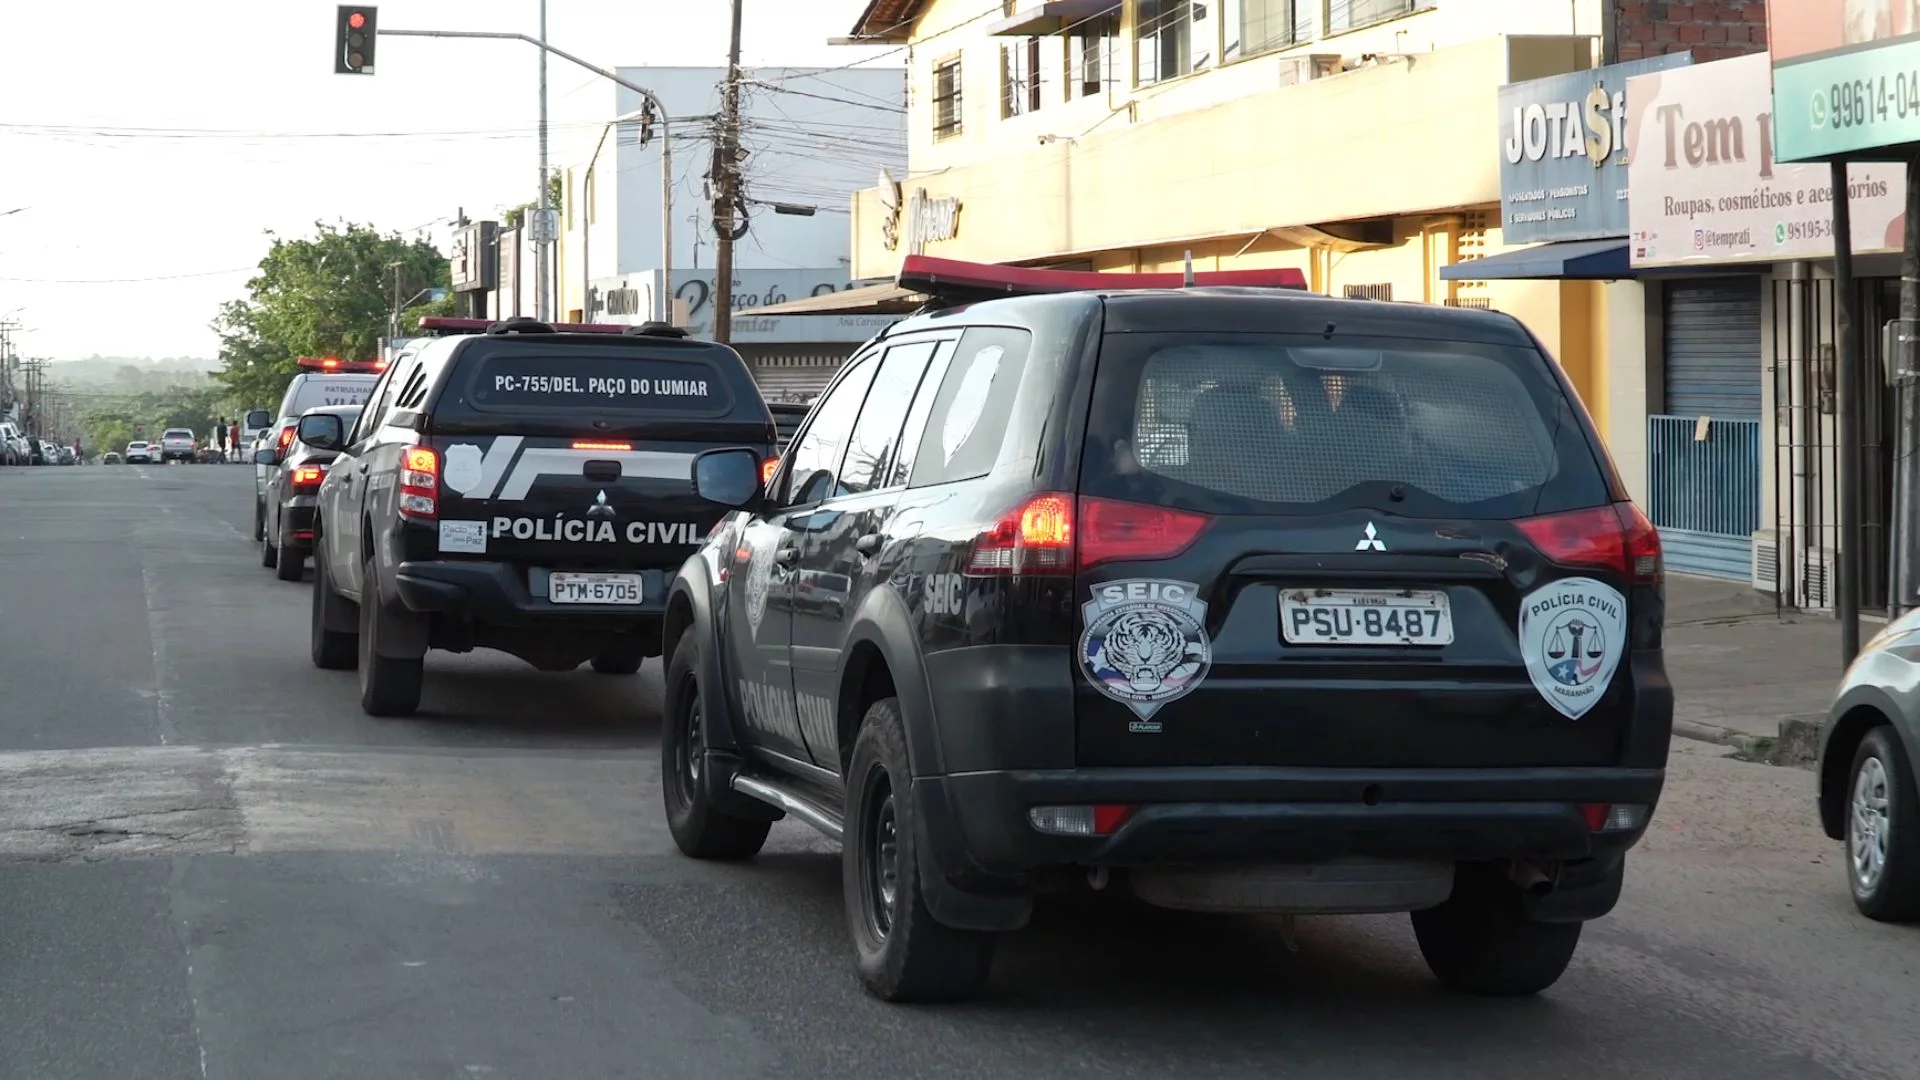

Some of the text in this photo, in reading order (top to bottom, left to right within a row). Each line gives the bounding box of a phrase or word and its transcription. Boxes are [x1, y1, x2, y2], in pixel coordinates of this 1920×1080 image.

[1656, 103, 1747, 169] Tem
[1664, 176, 1888, 220] Roupas, cosméticos e aceórios
[495, 375, 708, 398] PC-755/DEL. PAÇO DO LUMIAR
[492, 512, 705, 545] POLÍCIA CIVIL
[924, 573, 963, 616] SEIC
[1102, 582, 1185, 603] SEIC
[1532, 592, 1618, 620] POLÍCIA CIVIL
